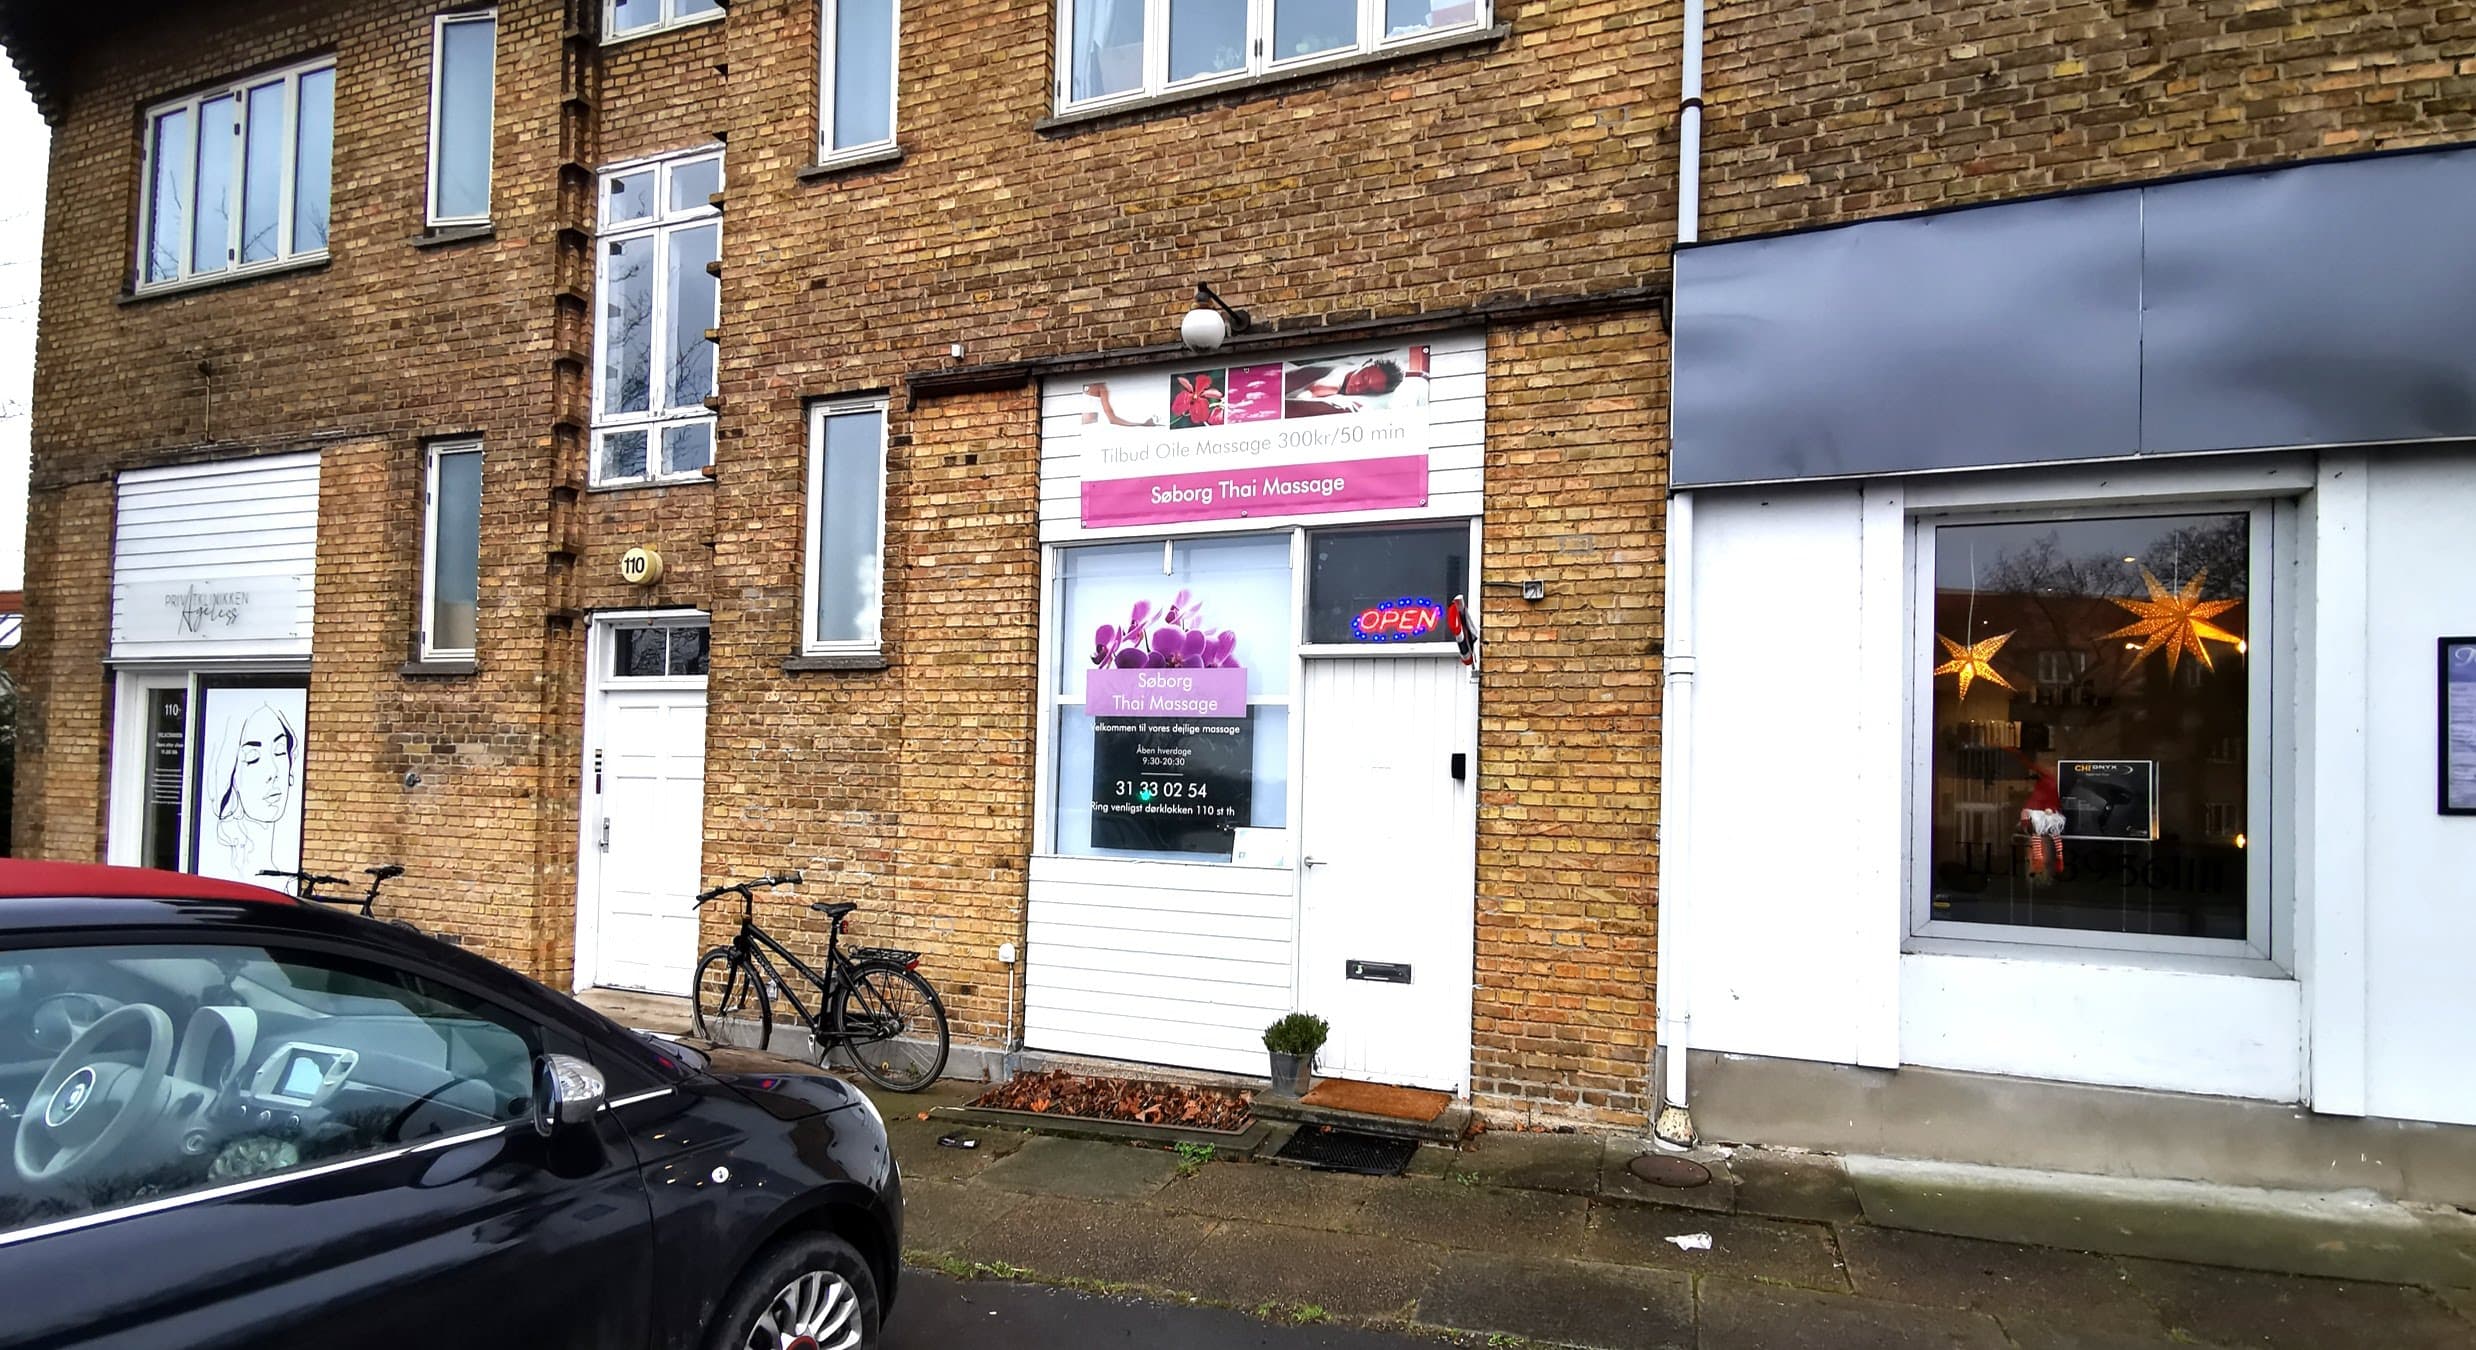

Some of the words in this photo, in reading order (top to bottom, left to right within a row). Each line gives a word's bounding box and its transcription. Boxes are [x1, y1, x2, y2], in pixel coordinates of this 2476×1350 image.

[1101, 443, 1150, 464] Tilbud
[1156, 442, 1190, 459] Oile
[1195, 438, 1272, 456] Massage
[1278, 426, 1364, 449] 300kr/50
[1371, 423, 1405, 440] min
[1151, 483, 1213, 504] Søborg
[1218, 479, 1257, 498] Thai
[1262, 476, 1345, 496] Massage
[624, 557, 645, 574] 110
[1360, 609, 1438, 630] OPEN
[1138, 672, 1193, 691] Søborg
[1112, 695, 1145, 711] Thai
[1149, 695, 1218, 714] Massage
[1139, 722, 1147, 732] til
[1148, 724, 1170, 733] vores
[1172, 723, 1200, 735] dejlige
[1202, 725, 1240, 735] massage
[1136, 743, 1155, 754] Åben
[1157, 745, 1192, 756] hverdage
[1142, 757, 1186, 767] 9:30-20:30
[1115, 780, 1133, 796] 31
[1139, 781, 1159, 797] 33
[1163, 782, 1183, 798] 02
[1187, 783, 1208, 799] 54
[1090, 802, 1109, 814] Ring
[1110, 803, 1143, 815] venligst
[1144, 803, 1194, 815] dørklokken
[1197, 805, 1214, 816] 110
[1217, 807, 1224, 816] st
[1226, 805, 1235, 816] th
